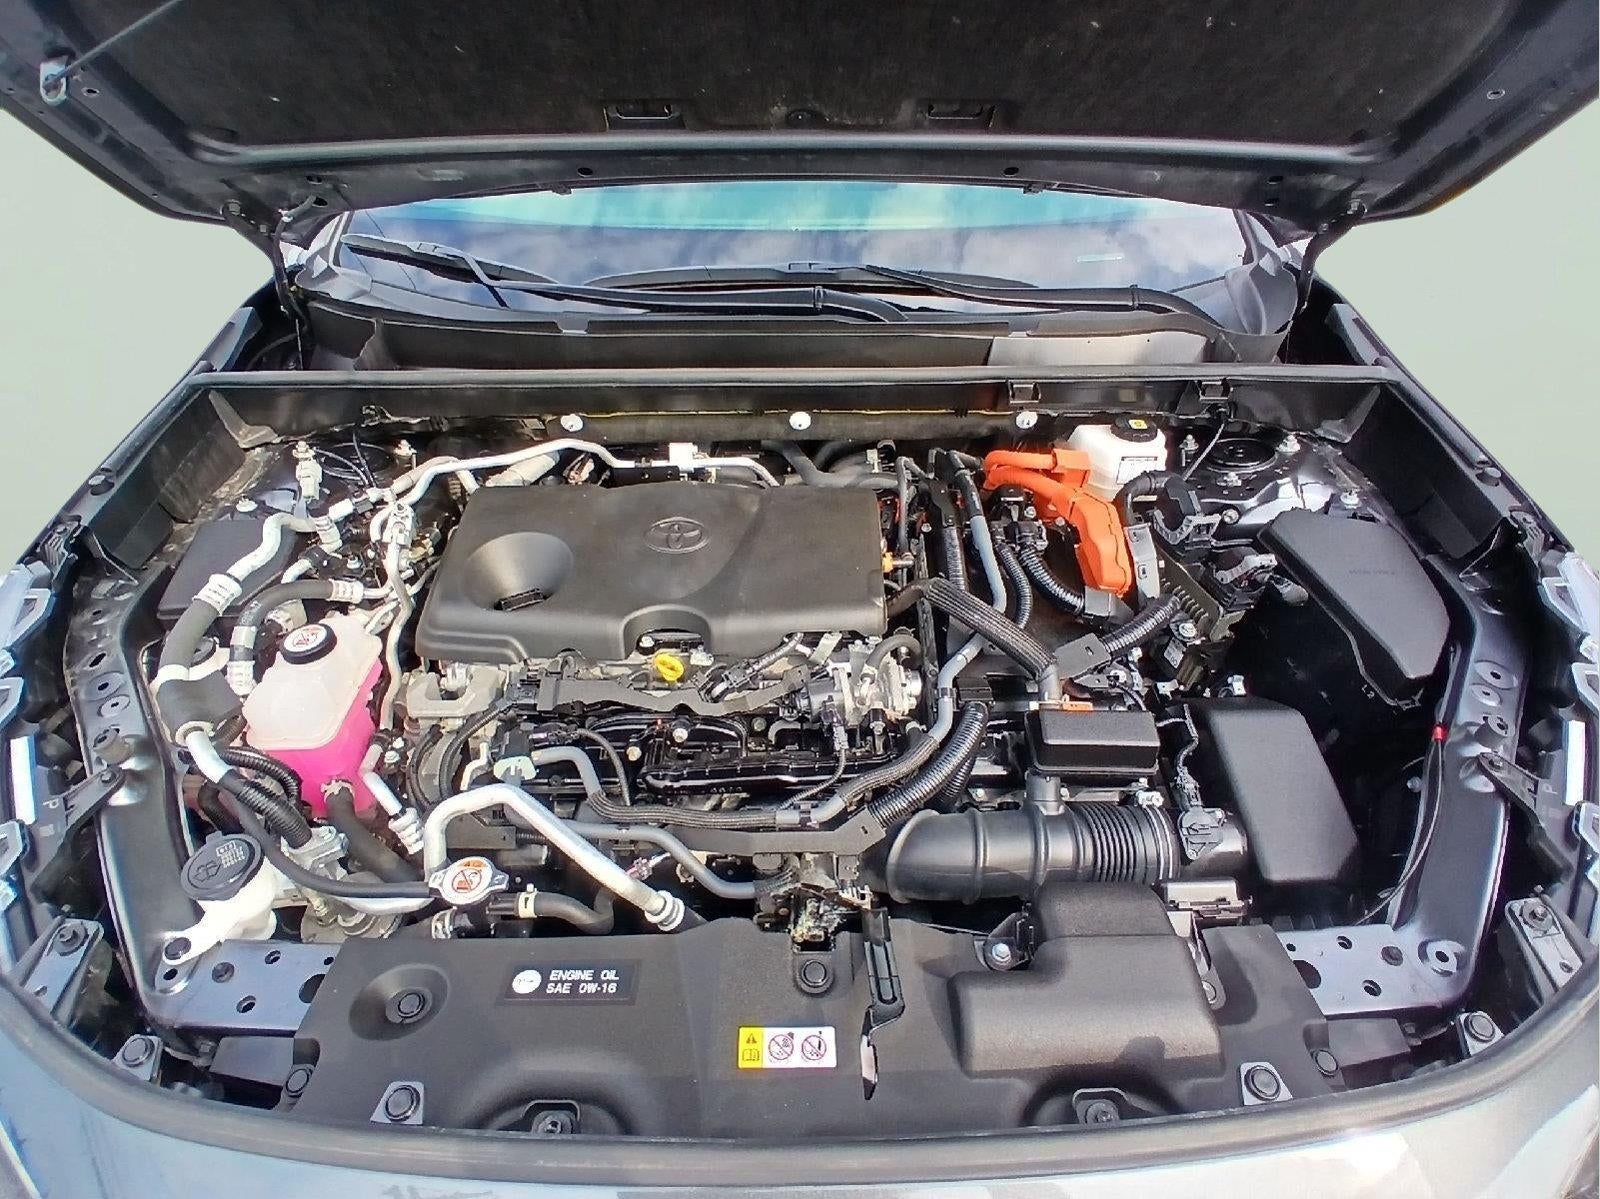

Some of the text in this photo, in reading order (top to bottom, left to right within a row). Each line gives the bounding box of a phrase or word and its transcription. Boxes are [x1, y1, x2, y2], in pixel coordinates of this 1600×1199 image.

[549, 969, 620, 981] ENGINE OIL
[545, 982, 618, 994] SAE 0W-16
